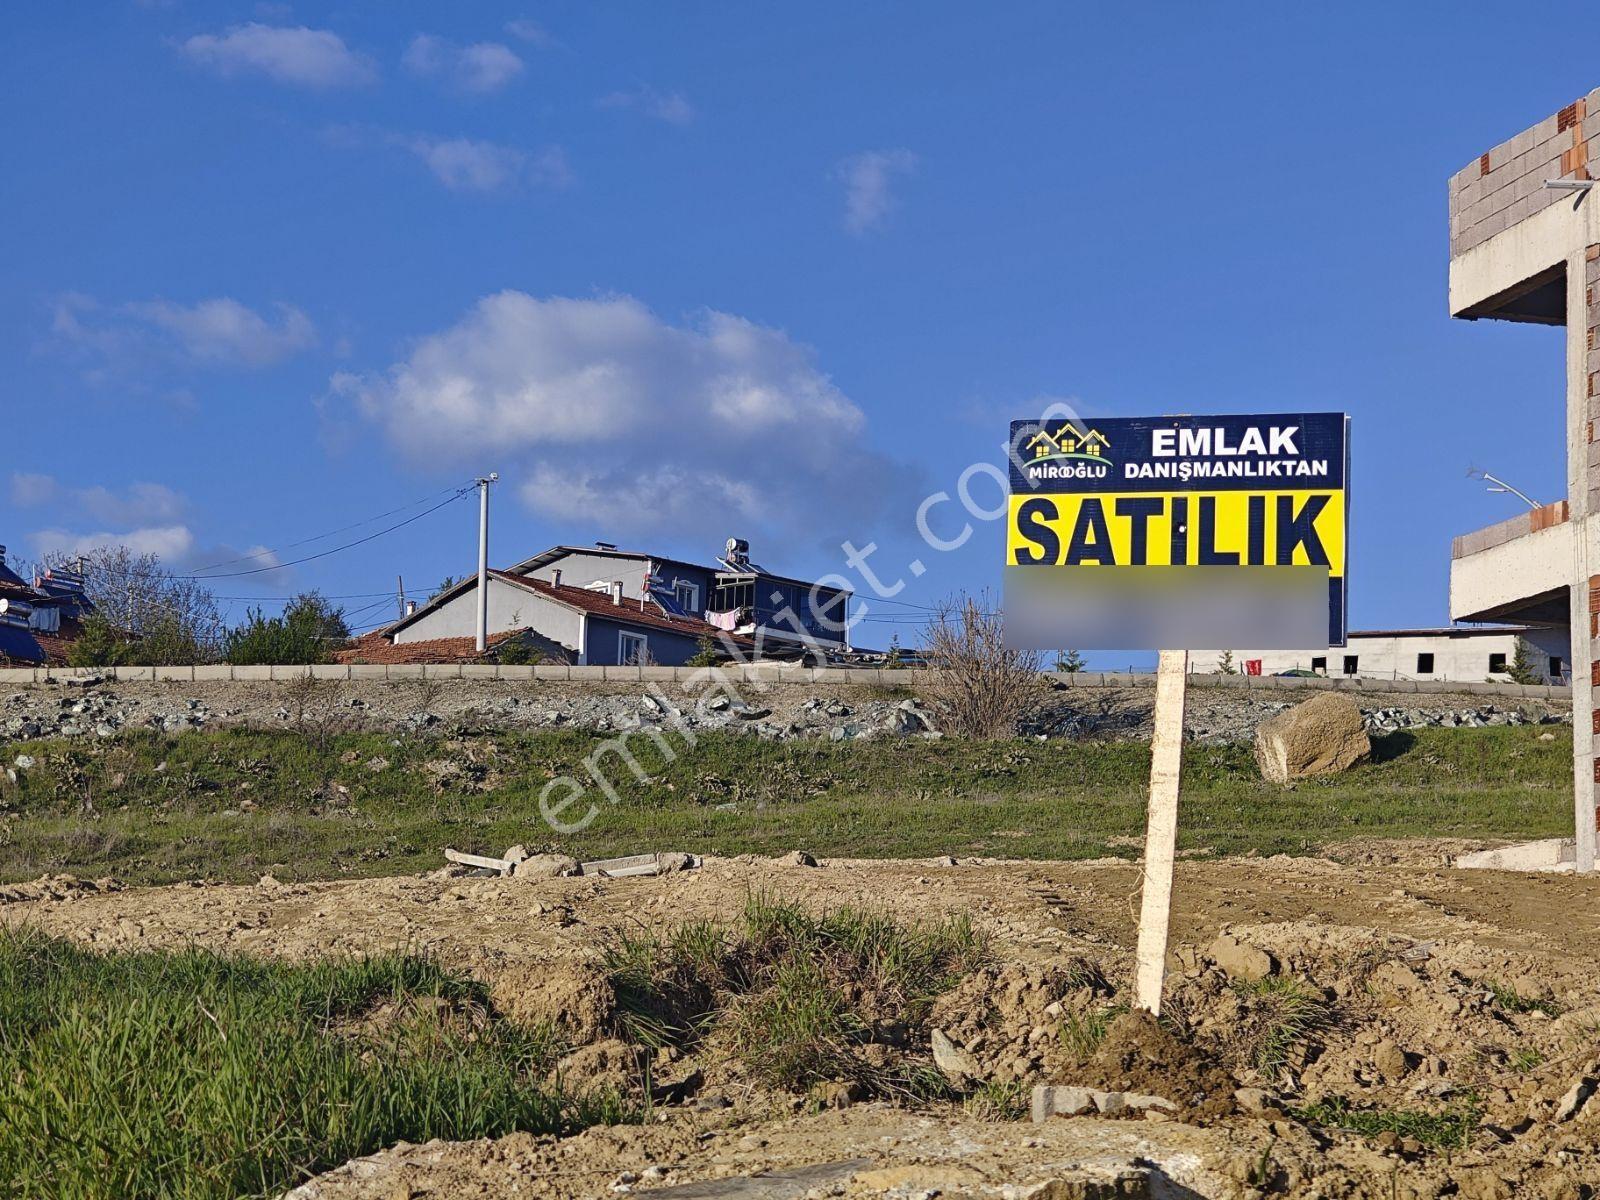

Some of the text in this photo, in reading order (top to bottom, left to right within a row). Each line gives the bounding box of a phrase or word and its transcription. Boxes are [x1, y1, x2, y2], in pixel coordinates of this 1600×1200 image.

[1152, 427, 1300, 457] EMLAK
[1124, 460, 1328, 482] DANIŞMANLIKTAN
[1014, 494, 1333, 570] SATILIK
